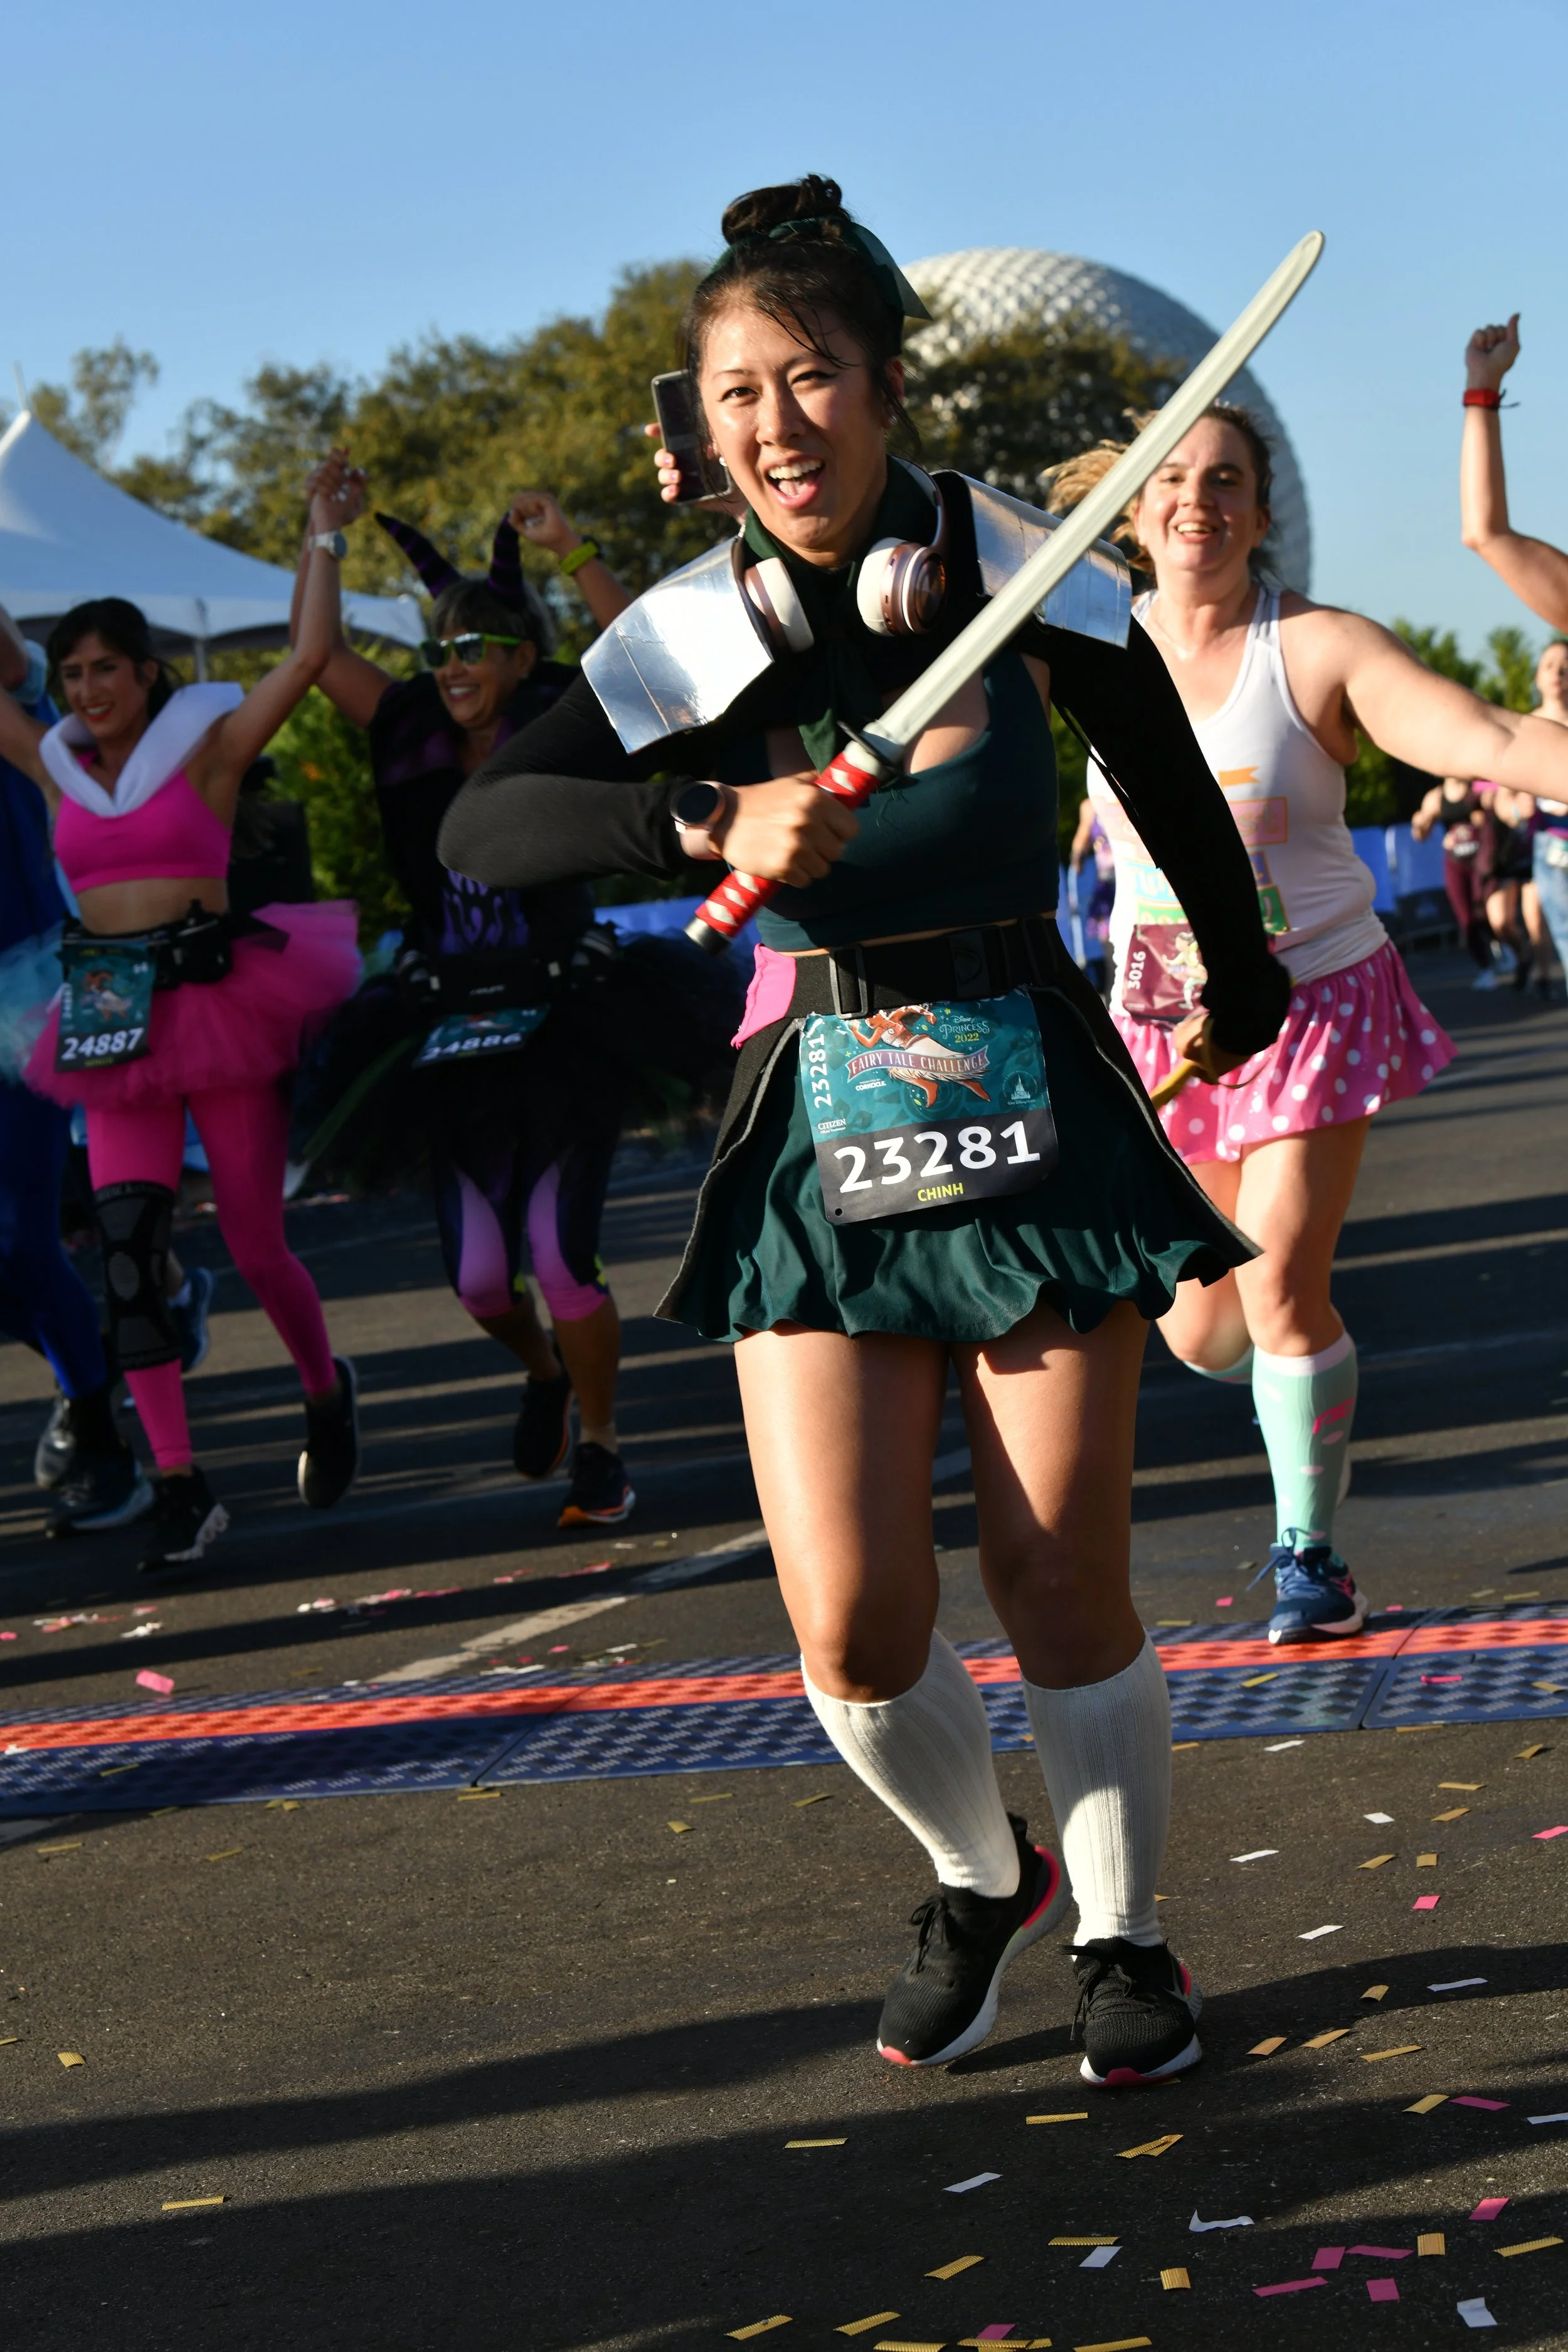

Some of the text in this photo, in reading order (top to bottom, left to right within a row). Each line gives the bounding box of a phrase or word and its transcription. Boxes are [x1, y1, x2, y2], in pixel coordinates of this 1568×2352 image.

[1127, 951, 1147, 990] 3016
[61, 1027, 144, 1061] 24887
[954, 1032, 980, 1044] 2022
[807, 1033, 832, 1110] 23281
[851, 1052, 984, 1074] FAIRY TALE CHALLENGE
[817, 1118, 847, 1130] CITIZEN
[833, 1120, 1041, 1194] 23281
[917, 1182, 964, 1202] CHINH
